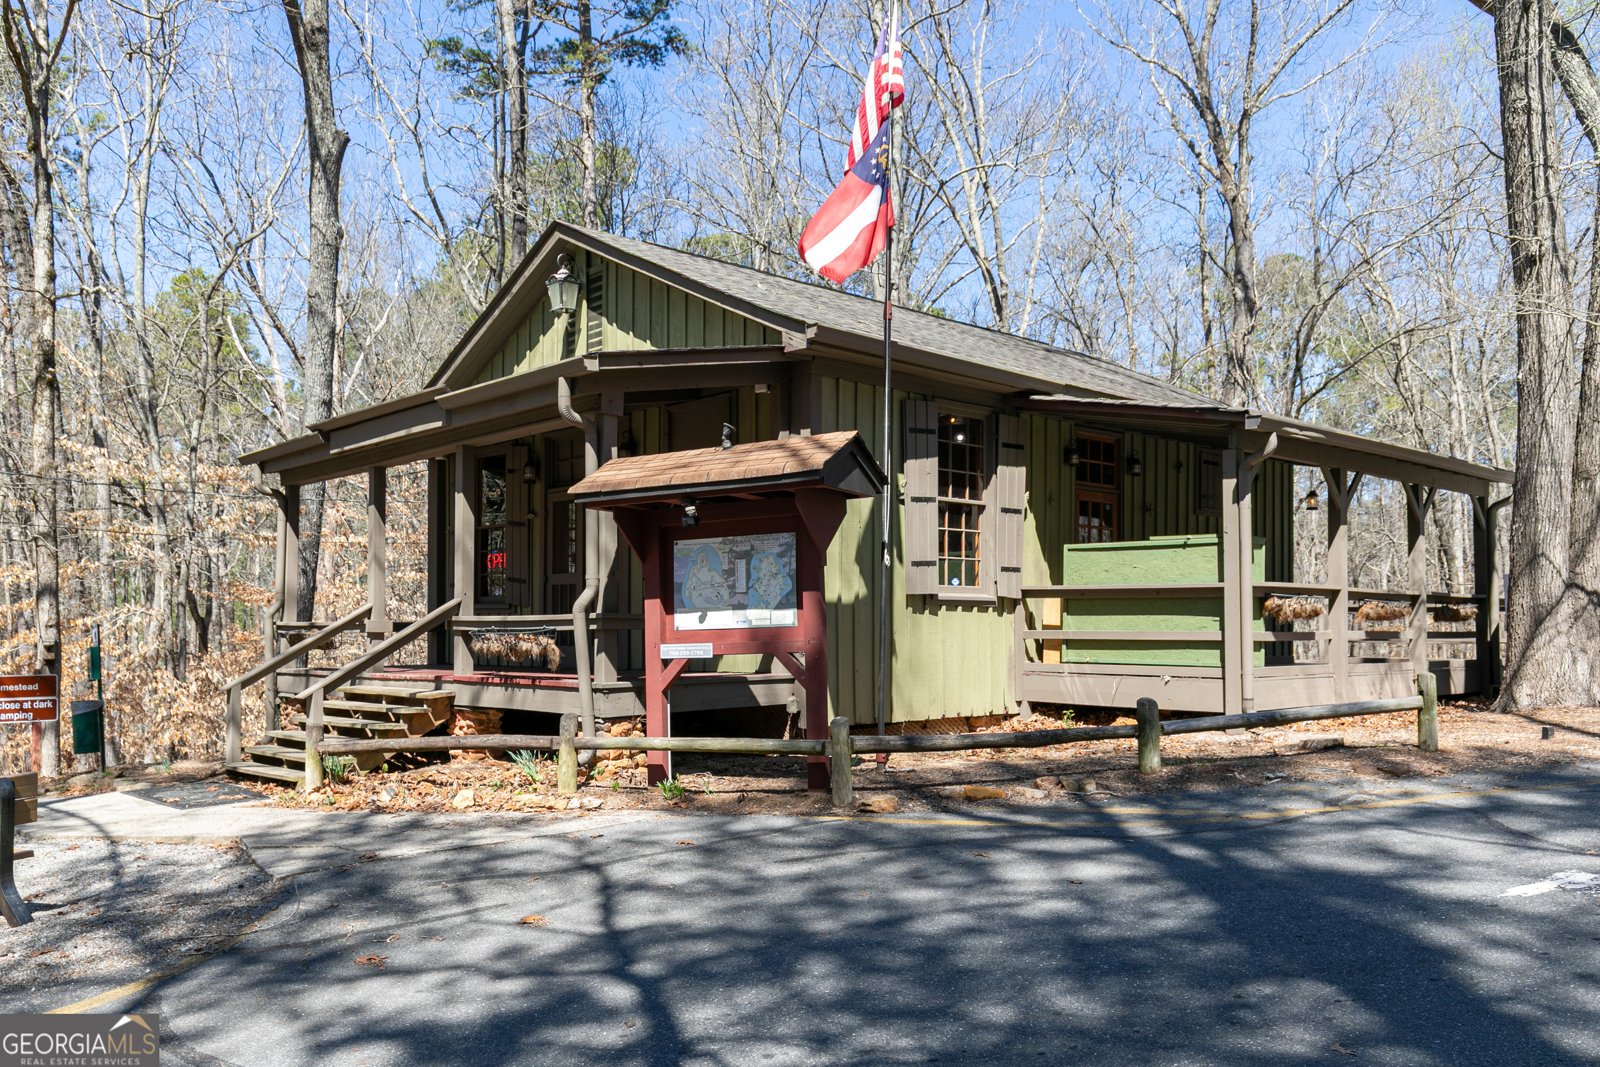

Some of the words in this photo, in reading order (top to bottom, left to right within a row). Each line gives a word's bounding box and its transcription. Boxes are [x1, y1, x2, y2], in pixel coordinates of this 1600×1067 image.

[487, 553, 507, 569] OPE
[0, 683, 39, 691] mestead
[22, 701, 31, 709] at
[33, 700, 53, 709] dark
[0, 711, 33, 721] amping
